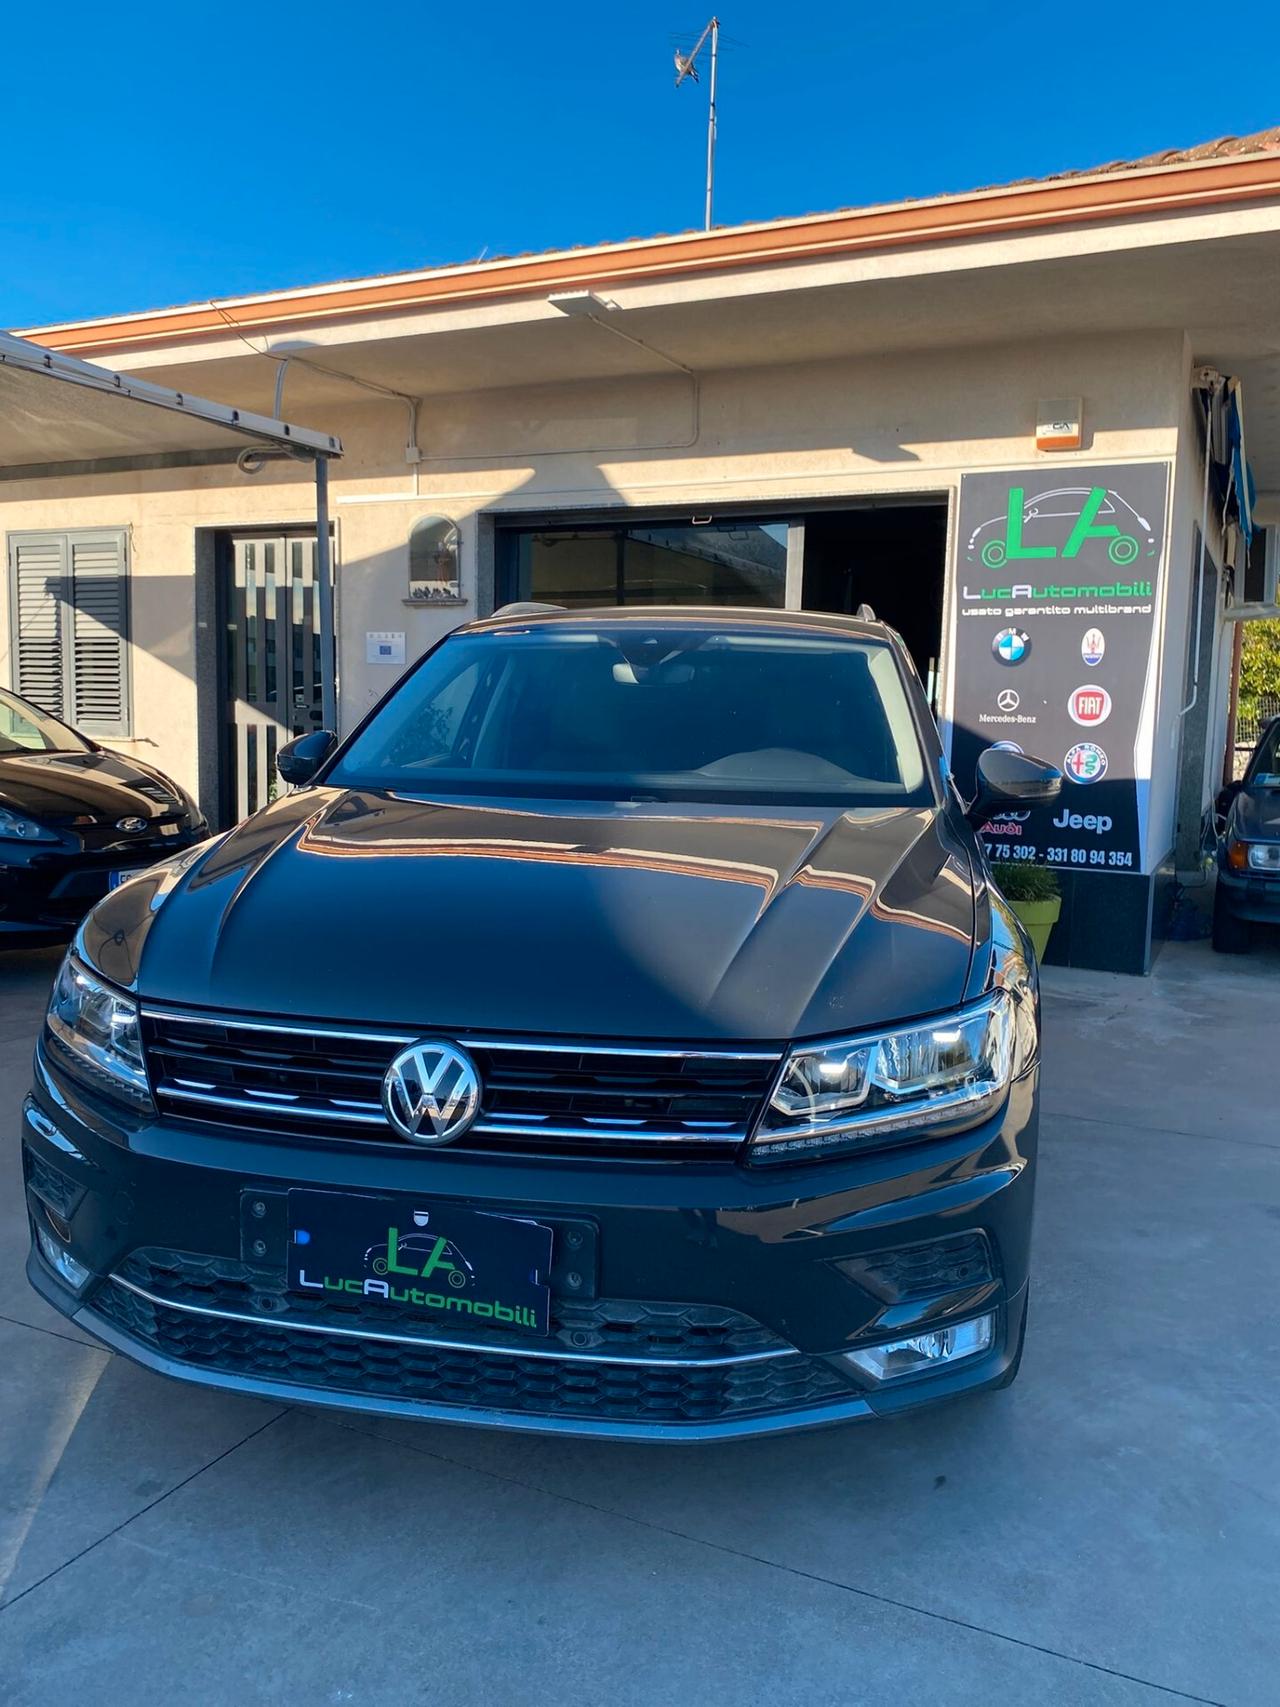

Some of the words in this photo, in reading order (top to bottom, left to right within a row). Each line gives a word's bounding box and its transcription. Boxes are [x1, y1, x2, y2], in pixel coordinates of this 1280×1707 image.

[1005, 486, 1121, 560] LA
[962, 582, 1152, 600] LucAutomobili
[961, 604, 1002, 616] usato
[1005, 604, 1071, 617] garantito
[1074, 603, 1152, 615] multibrand
[1078, 696, 1103, 715] FIAT
[979, 713, 1037, 723] Mercedes-Benz
[1053, 808, 1113, 834] Jeep
[996, 843, 1010, 858] 75
[1013, 844, 1036, 860] 302
[1046, 847, 1068, 862] 331
[1070, 848, 1087, 864] 80
[1089, 849, 1105, 865] 94
[1108, 851, 1133, 867] 354
[299, 1269, 537, 1328] LucAutomobili
